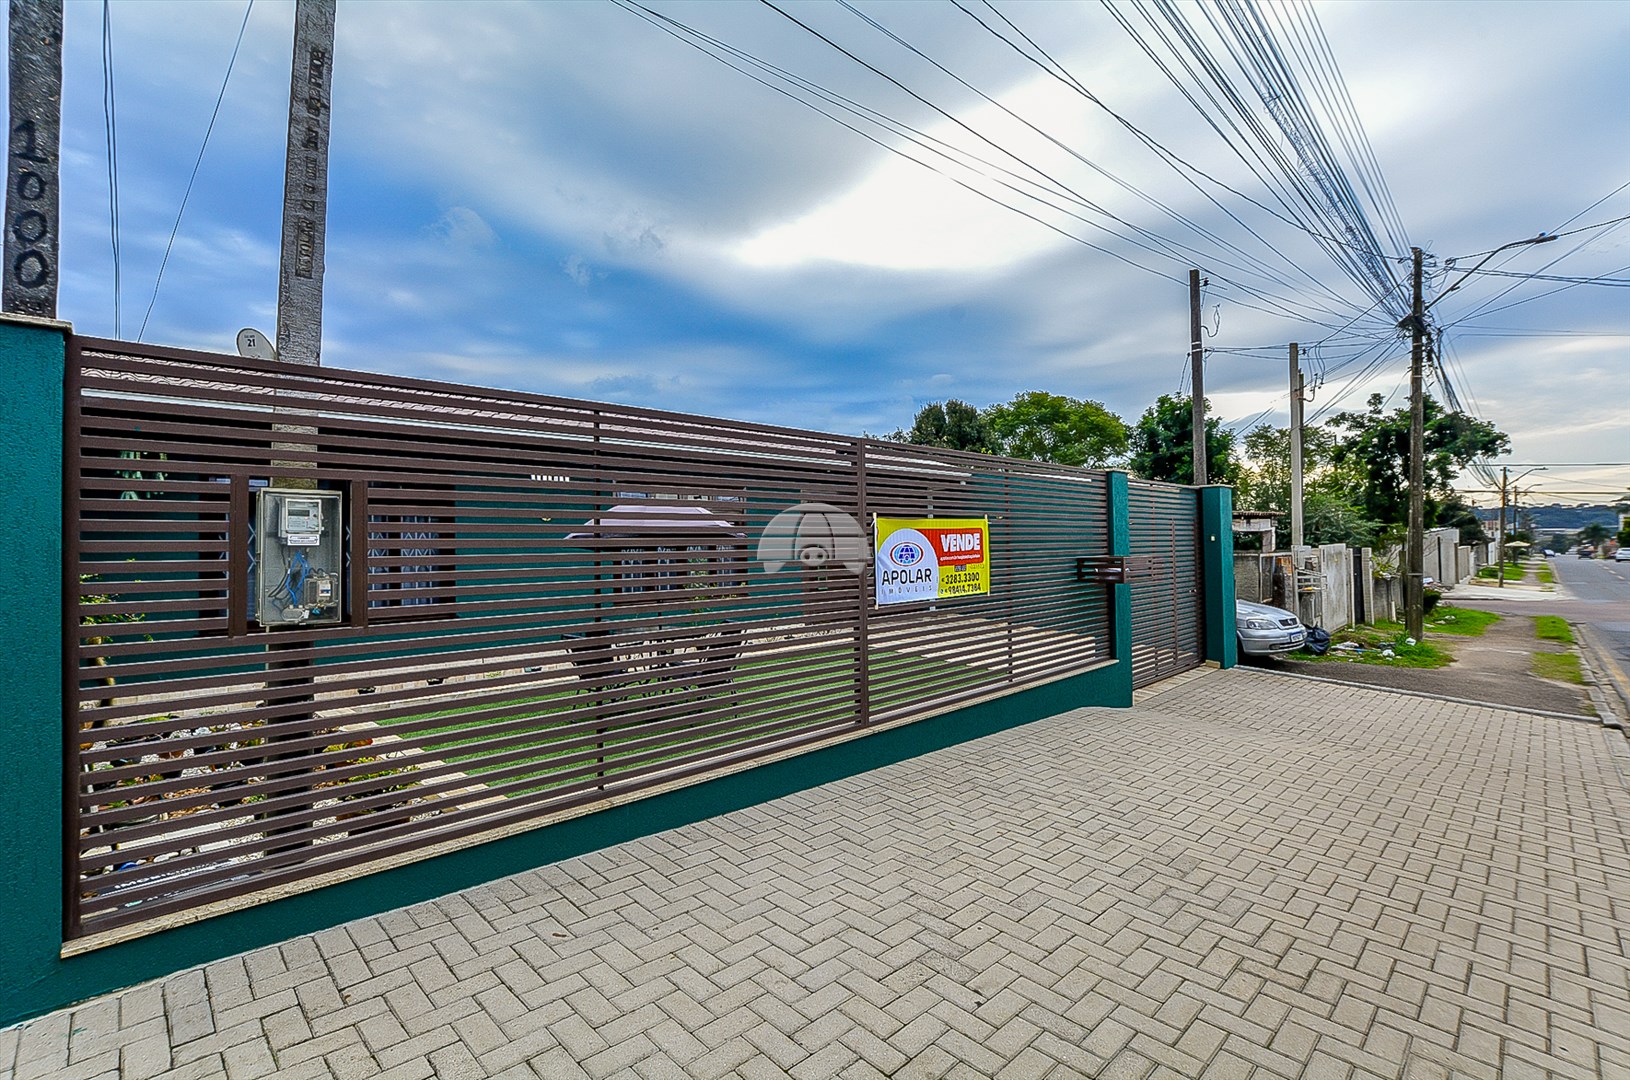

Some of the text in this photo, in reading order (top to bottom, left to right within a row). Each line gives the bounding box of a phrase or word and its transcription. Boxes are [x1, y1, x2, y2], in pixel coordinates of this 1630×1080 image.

[247, 338, 256, 347] 21
[940, 533, 980, 552] VENDE
[881, 568, 932, 585] APOLAR
[945, 572, 980, 585] 3283.3300
